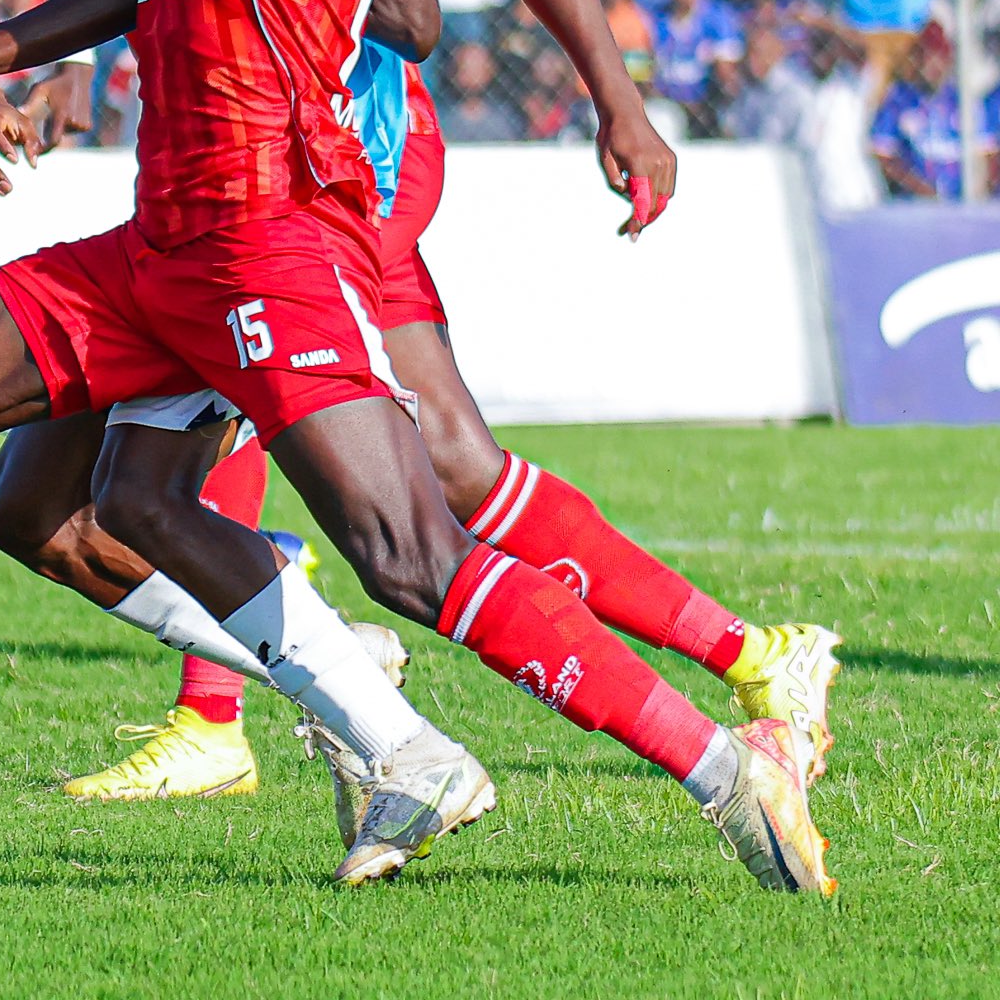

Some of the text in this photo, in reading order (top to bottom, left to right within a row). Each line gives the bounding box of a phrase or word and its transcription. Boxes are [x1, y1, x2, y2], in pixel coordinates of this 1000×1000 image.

[226, 298, 275, 370] 15
[290, 348, 341, 369] SANDA
[544, 655, 579, 709] LAND
